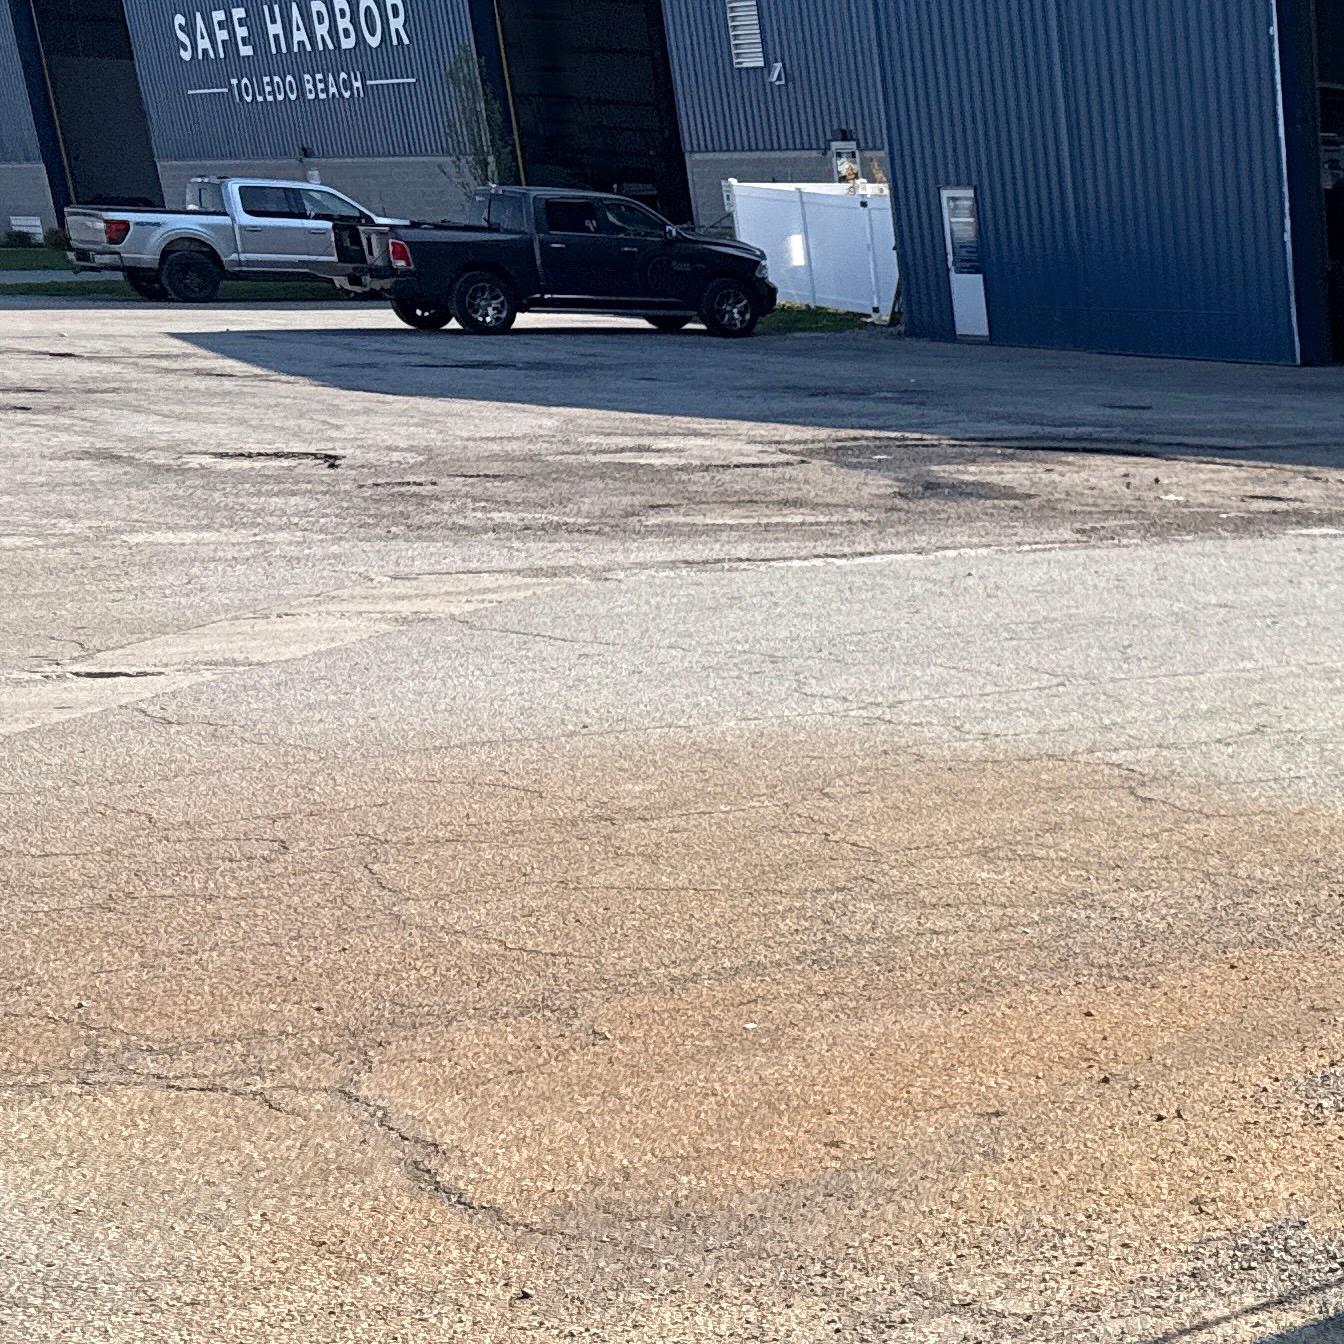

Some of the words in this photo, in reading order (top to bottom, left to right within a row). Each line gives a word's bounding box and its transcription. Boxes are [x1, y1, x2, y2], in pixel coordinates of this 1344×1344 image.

[174, 7, 254, 61] SAFE
[263, 0, 410, 54] HARBOR
[230, 74, 298, 103] TOLEDO
[303, 71, 365, 100] BEACH
